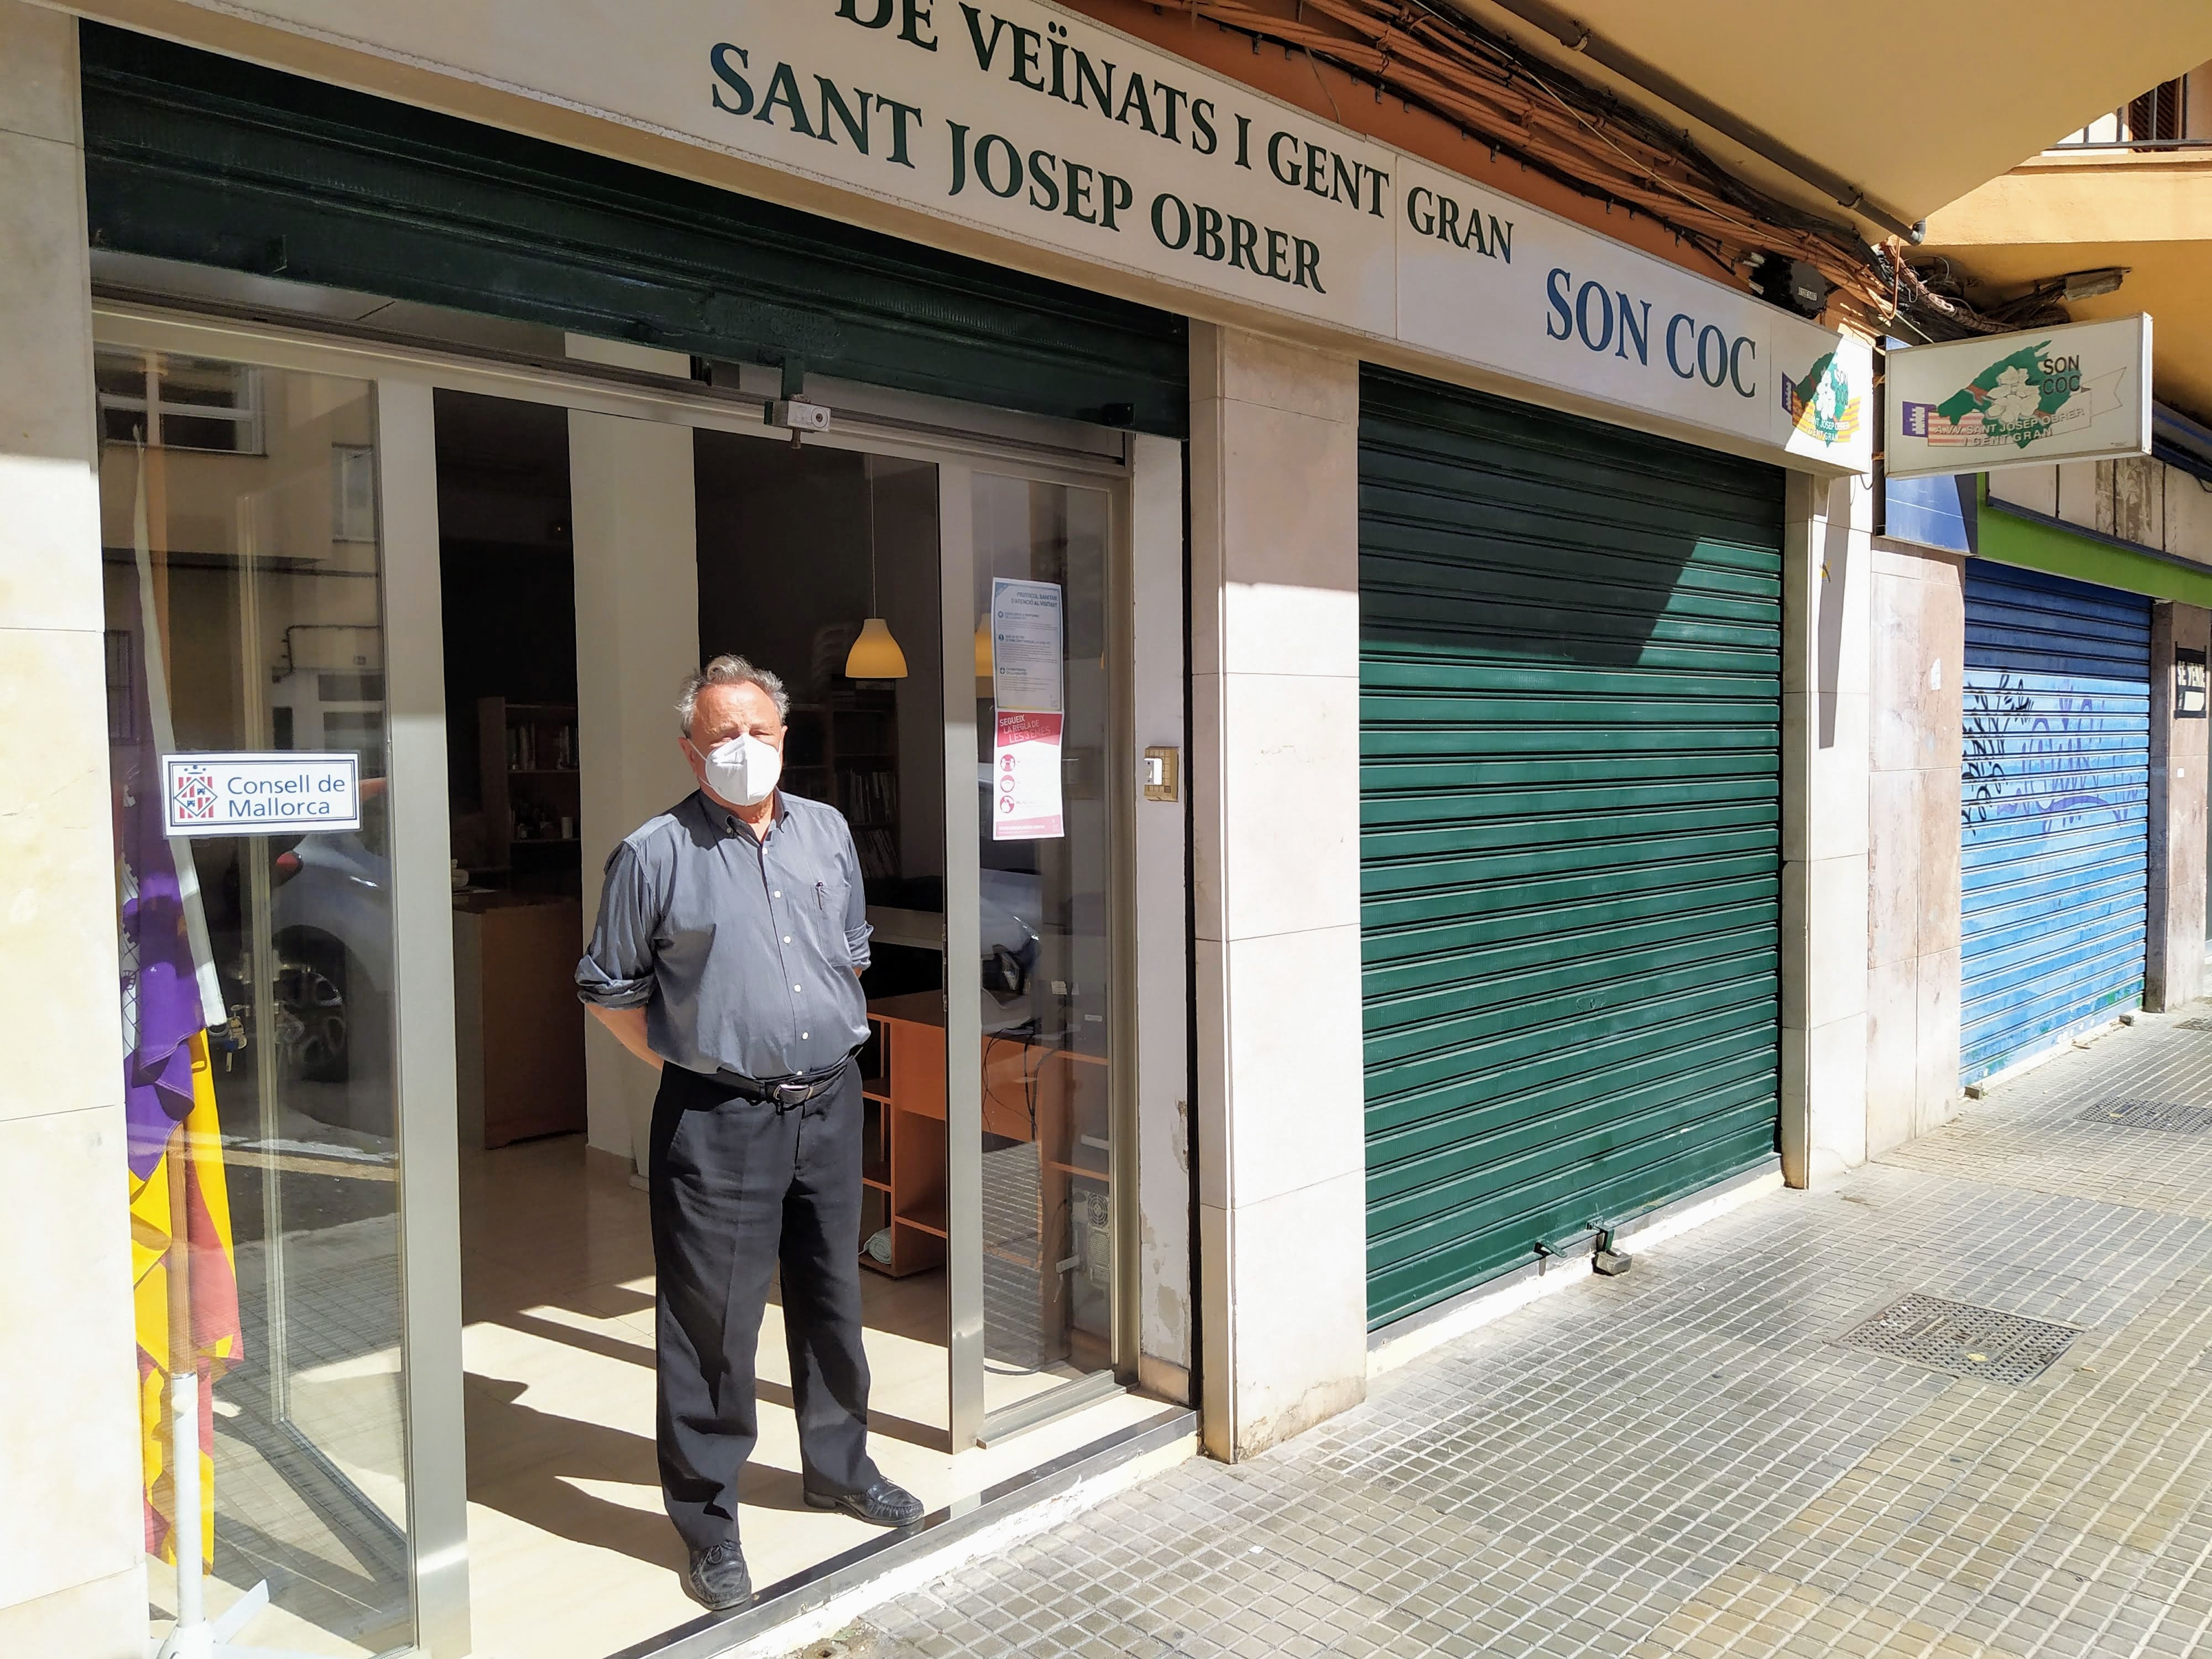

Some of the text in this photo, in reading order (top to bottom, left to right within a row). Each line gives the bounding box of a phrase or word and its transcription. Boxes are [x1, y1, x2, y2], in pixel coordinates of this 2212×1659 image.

[959, 2, 1217, 154] VEÏNATS
[1234, 113, 1251, 170] I
[1268, 132, 1389, 218] GENT
[1408, 187, 1514, 264] GRAN
[711, 43, 1326, 294] SANT JOSEP OBRER
[1547, 268, 1755, 398] SON COC
[2043, 354, 2080, 375] SON
[2043, 374, 2081, 395] COC
[1820, 419, 1834, 430] JOSEP
[1967, 424, 1997, 434] SANT
[2000, 419, 2038, 432] JOSEP
[2041, 408, 2085, 425] OBRER
[1972, 435, 2010, 446] GENT
[2013, 427, 2053, 442] GRAN
[999, 714, 1025, 727] SEGUEIX
[1013, 722, 1031, 733] REGLA
[1031, 719, 1040, 728] DE
[1009, 732, 1025, 744] LES
[1025, 731, 1030, 739] 3
[227, 774, 346, 795] Consell de
[229, 797, 330, 817] Mallorca
